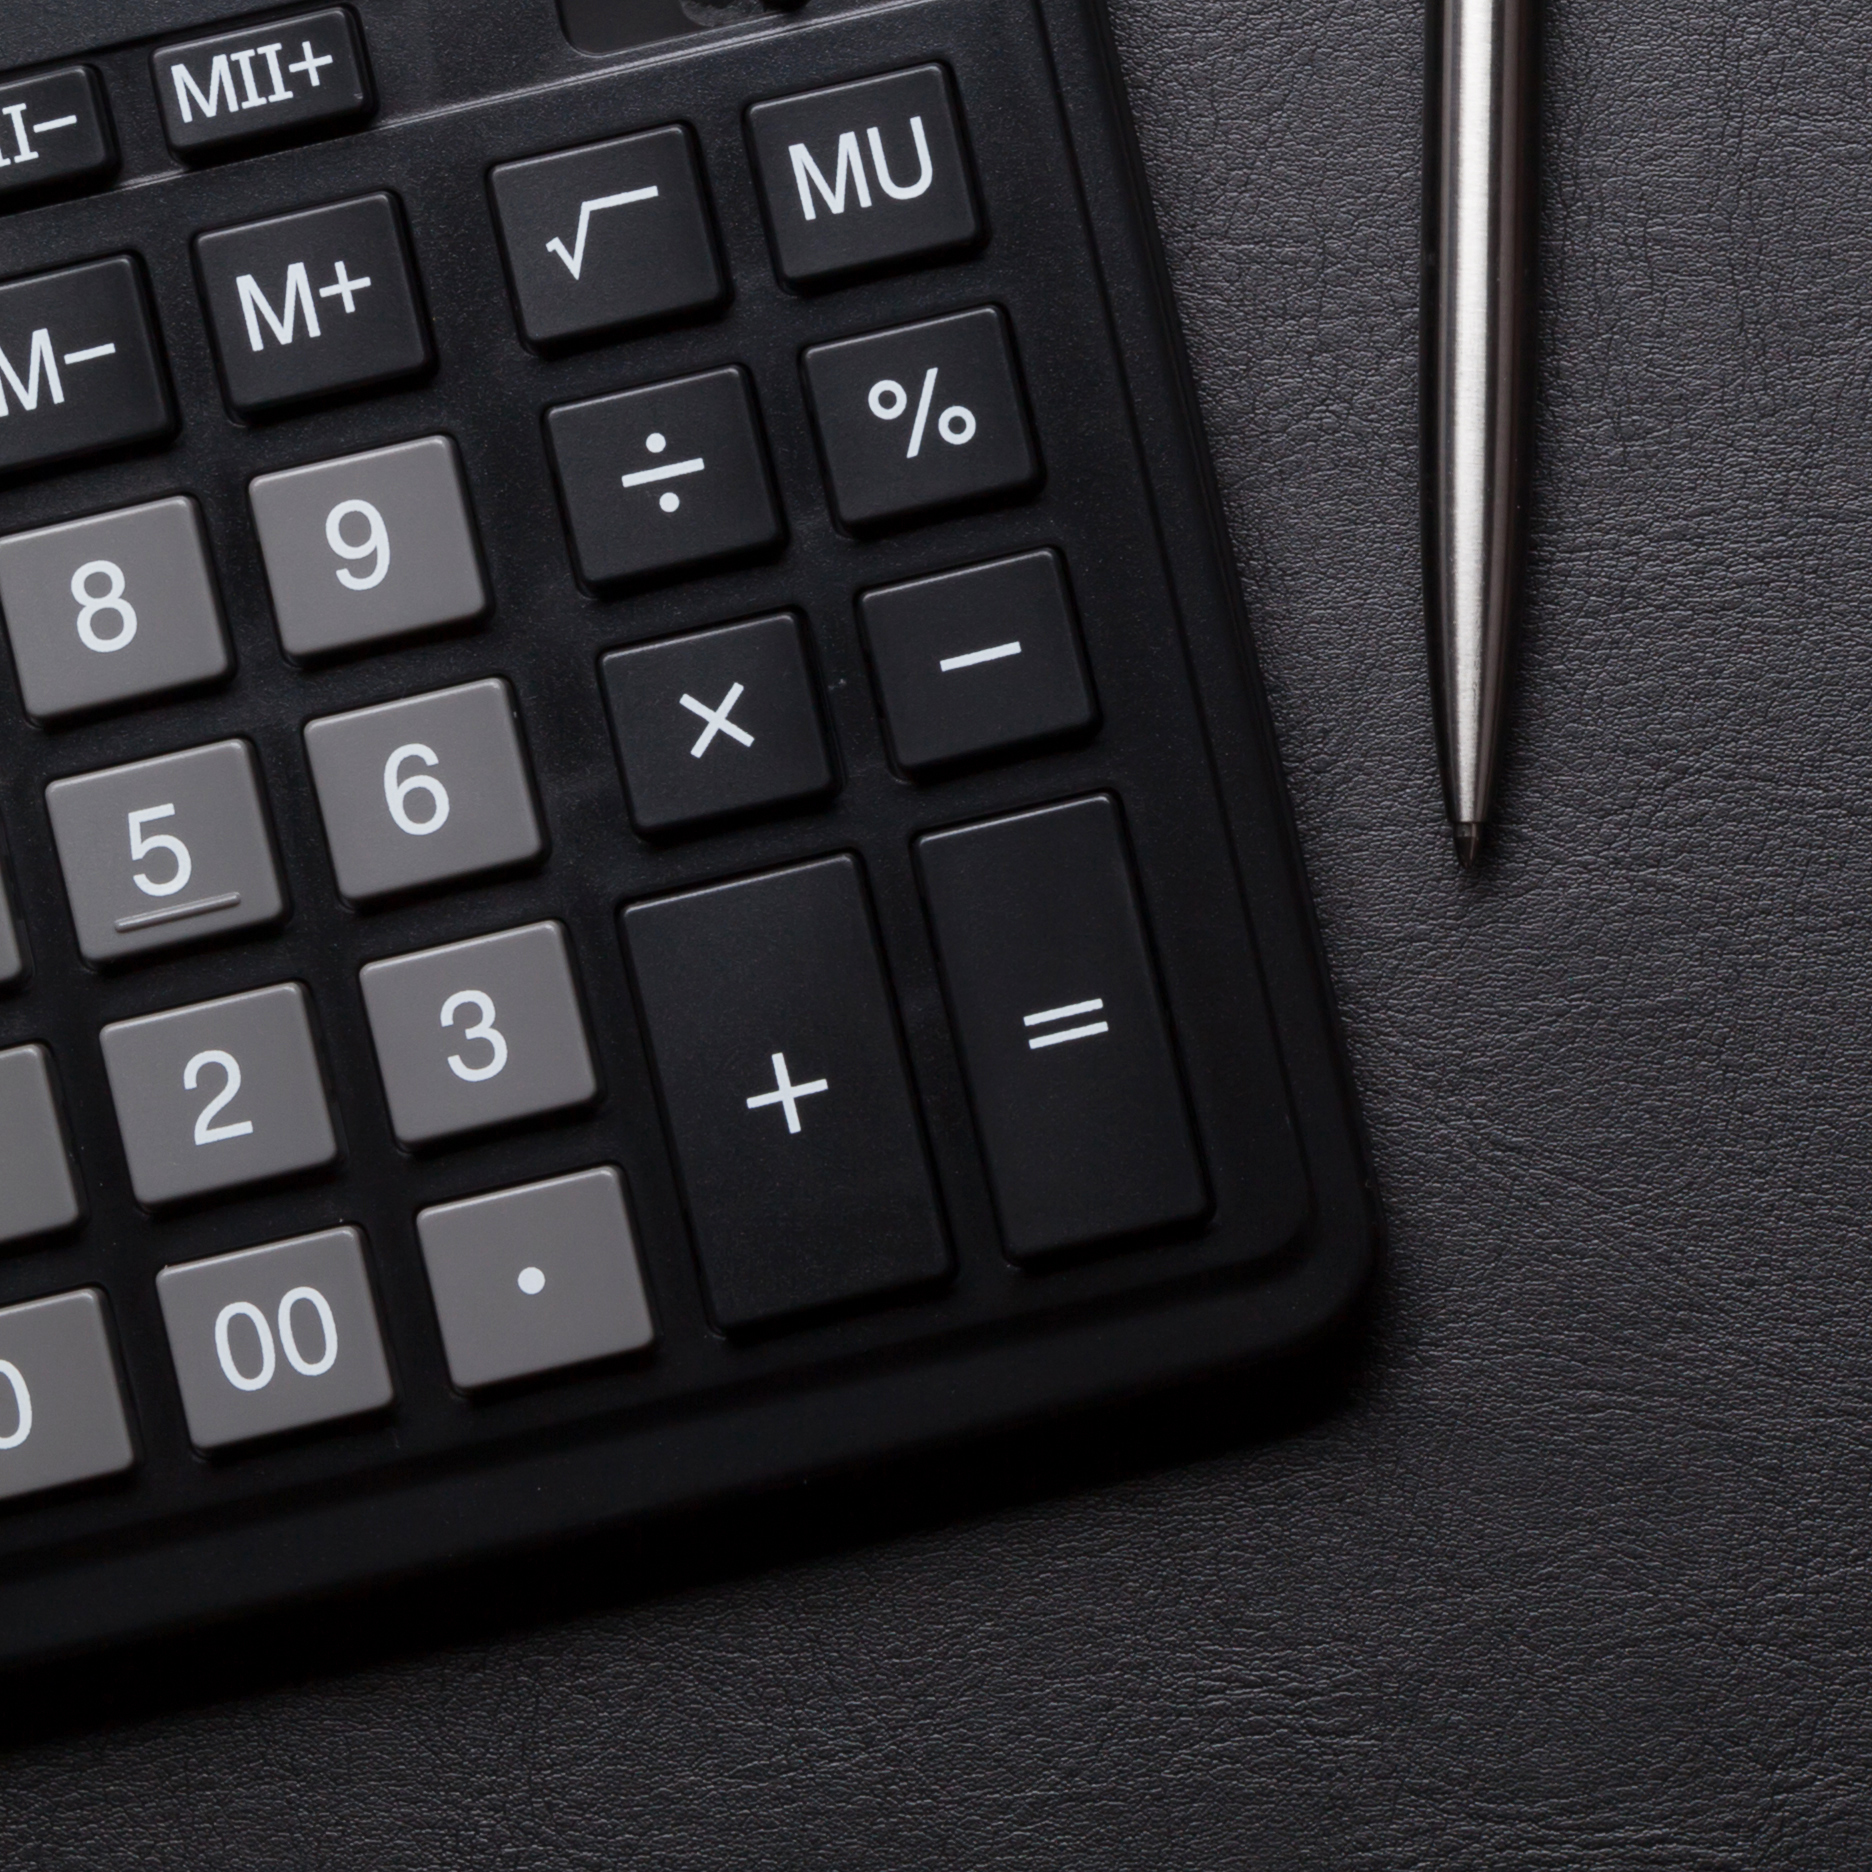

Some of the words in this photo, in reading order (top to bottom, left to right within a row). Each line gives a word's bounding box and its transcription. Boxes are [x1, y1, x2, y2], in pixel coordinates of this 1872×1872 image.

[170, 42, 333, 123] MII+
[0, 102, 77, 167] I-
[788, 116, 933, 221] MU
[236, 261, 371, 352] M+
[868, 367, 976, 458] %
[325, 499, 391, 591] 9
[70, 559, 138, 653] 8
[383, 743, 450, 836] 6
[127, 803, 192, 897] 5
[440, 989, 508, 1082] 3
[183, 1049, 253, 1146] 2
[214, 1286, 338, 1391] 00
